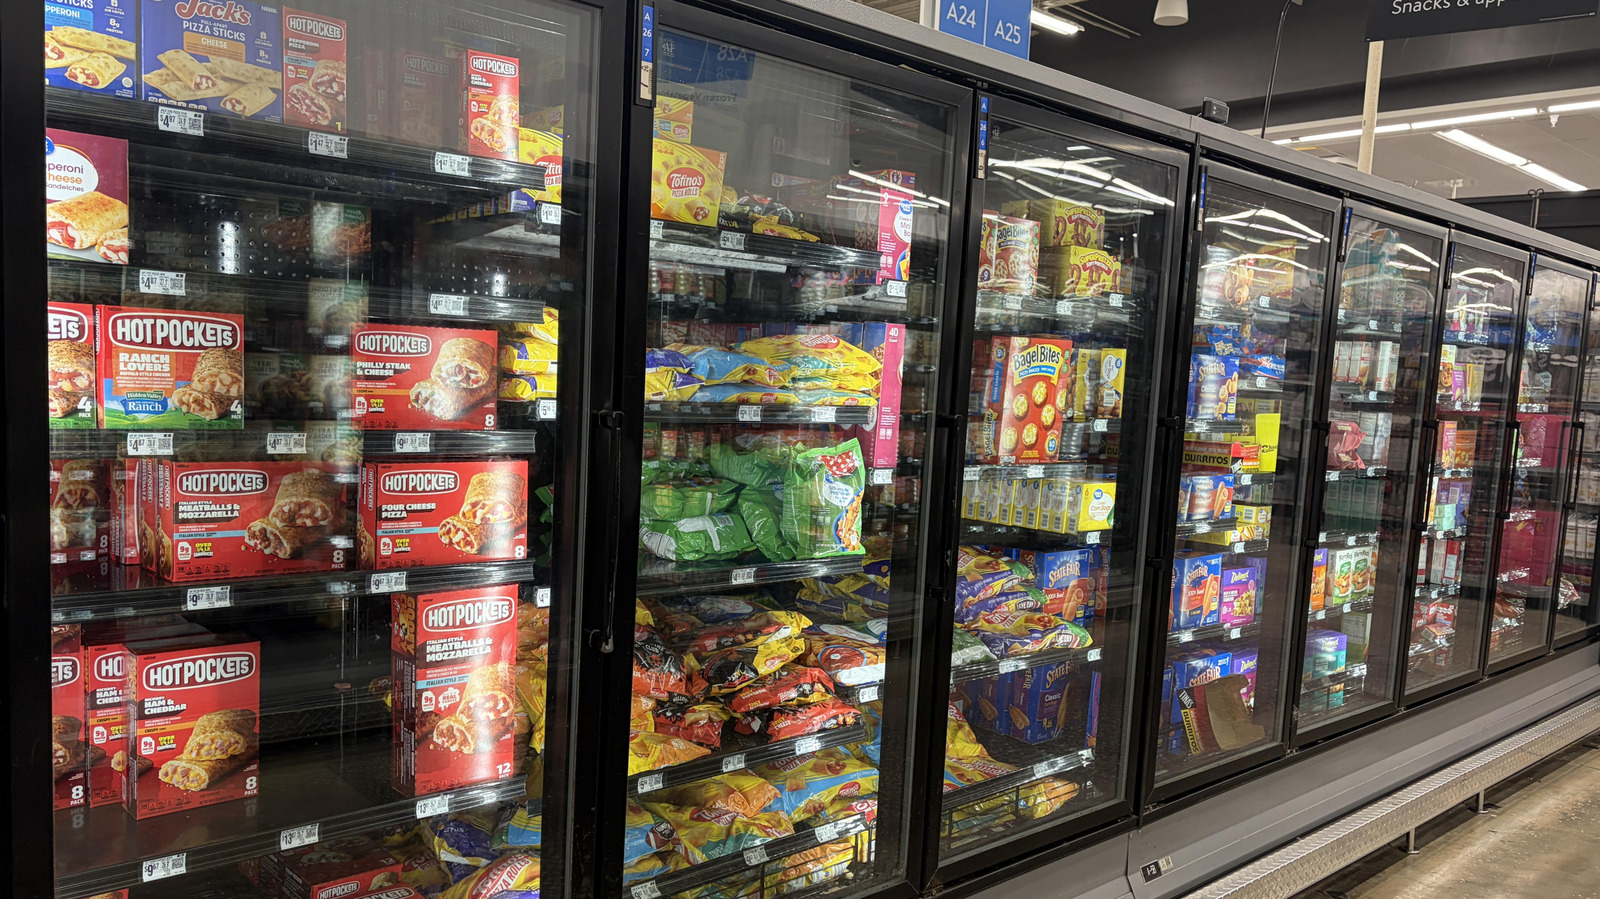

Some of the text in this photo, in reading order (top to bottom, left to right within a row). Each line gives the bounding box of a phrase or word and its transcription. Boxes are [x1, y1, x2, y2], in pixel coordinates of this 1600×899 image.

[174, 0, 251, 26] Jack's
[1392, 0, 1451, 15] Snacks
[947, 1, 976, 29] A24
[183, 21, 246, 41] PIZZA STICKS
[290, 18, 341, 38] HOT POCKETS
[643, 12, 652, 57] A 26 7
[994, 20, 1021, 45] A25
[201, 37, 228, 48] CHEESE
[473, 58, 515, 75] HOT POCKETS
[48, 173, 83, 184] heese
[669, 173, 703, 188] Totino's
[671, 187, 699, 198] PIZZA ROLLS
[117, 318, 234, 347] HOT POCKETS
[889, 327, 899, 337] 40
[360, 335, 427, 353] HOT POCKETS
[119, 352, 170, 364] RANCH
[1012, 345, 1060, 371] Bagel Bites
[119, 362, 170, 372] LOVERS
[357, 361, 411, 370] PHILLY STEAK
[147, 392, 162, 400] Valley
[77, 397, 92, 412] 4
[128, 401, 162, 411] Ranch
[230, 400, 242, 413] 4
[485, 414, 494, 427] 8
[1184, 453, 1229, 464] BURRITOS
[182, 473, 264, 493] HOT POCKETS
[385, 473, 455, 492] HOT POCKETS
[179, 504, 232, 512] MEATBALLS
[179, 511, 239, 519] MOZZARELLA
[100, 534, 108, 548] 8
[332, 550, 343, 563] 8
[514, 545, 524, 558] 8
[1049, 566, 1066, 588] STATE
[429, 600, 510, 627] HOT POCKETS
[426, 637, 493, 653] MEATBALLS &
[426, 646, 491, 662] MOZZARELLA
[150, 656, 250, 686] HOT POCKETS
[1045, 662, 1066, 689] STATE
[1206, 665, 1221, 680] FAIR
[96, 690, 117, 698] HAM
[1044, 692, 1062, 702] Classic
[145, 700, 166, 708] HAM
[145, 703, 187, 715] CHEDDAR
[1183, 710, 1199, 753] BURRITOS
[143, 740, 153, 748] 9g
[496, 762, 510, 774] 12
[245, 776, 257, 789] 8
[71, 785, 84, 799] 8
[508, 858, 530, 880] ROLLS
[319, 881, 358, 899] HOT POCKETS
